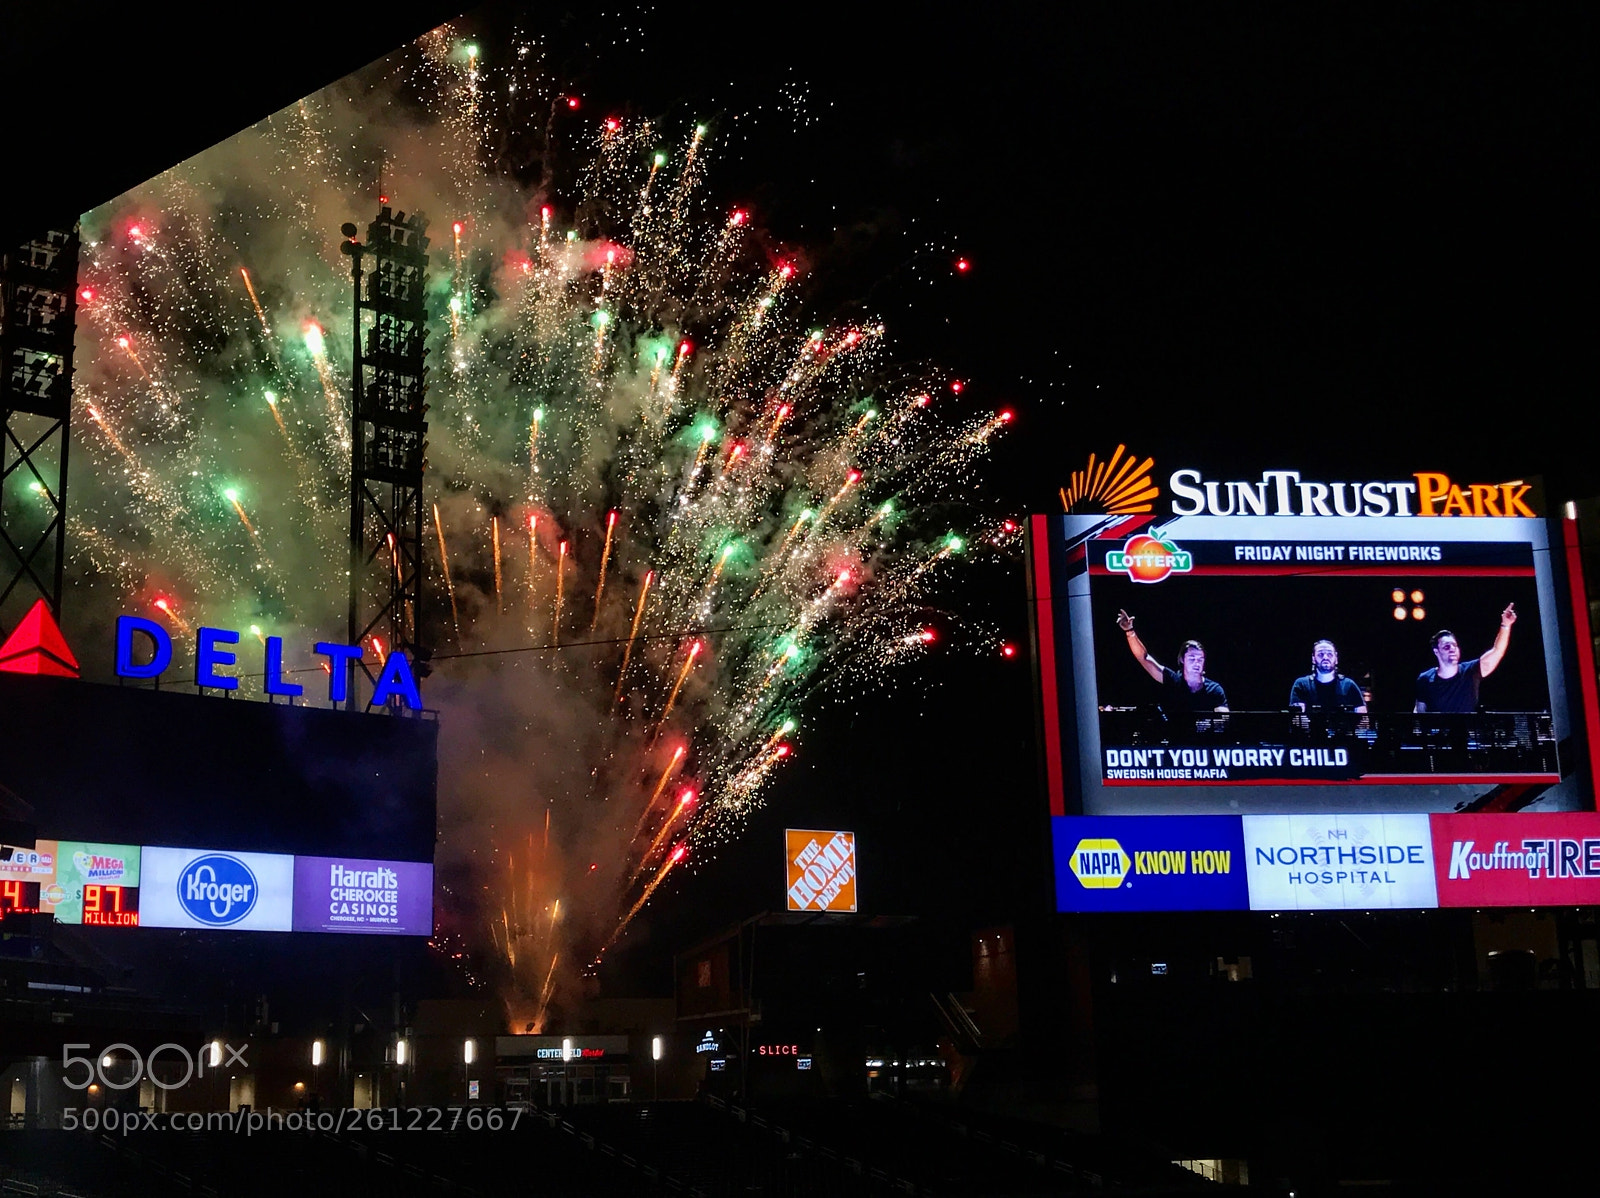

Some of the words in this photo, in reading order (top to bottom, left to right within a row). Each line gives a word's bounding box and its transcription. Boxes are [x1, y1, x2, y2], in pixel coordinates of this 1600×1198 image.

[1112, 555, 1187, 568] LOTTERY
[1234, 546, 1292, 561] FRIDAY
[1296, 546, 1345, 561] NIGHT
[1348, 546, 1441, 561] FIREWORKS
[115, 615, 422, 710] DELTA
[1106, 748, 1164, 767] DON'T
[1168, 748, 1208, 767] YOU
[1213, 748, 1284, 767] WORRY
[1289, 748, 1348, 767] CHILD
[1107, 769, 1154, 779] SWEDISH
[1156, 769, 1193, 779] HOUSE
[1194, 768, 1228, 779] MAFIA
[92, 855, 124, 870] MEGA
[793, 838, 822, 871] THE
[1079, 852, 1121, 875] NAPA
[1134, 851, 1186, 875] KNOW
[1191, 851, 1231, 875] HOW
[1255, 846, 1425, 865] NORTHSIDE
[1449, 841, 1549, 879] Kauffman
[788, 831, 855, 911] HOME
[1289, 871, 1396, 884] HOSPITAL
[187, 865, 252, 918] Kroger
[330, 888, 398, 903] CHEROKEE
[815, 861, 855, 911] DEPOT
[85, 885, 120, 912] 97
[84, 912, 138, 924] MILLION
[329, 902, 398, 916] CASINOS
[759, 1045, 798, 1055] SLICE
